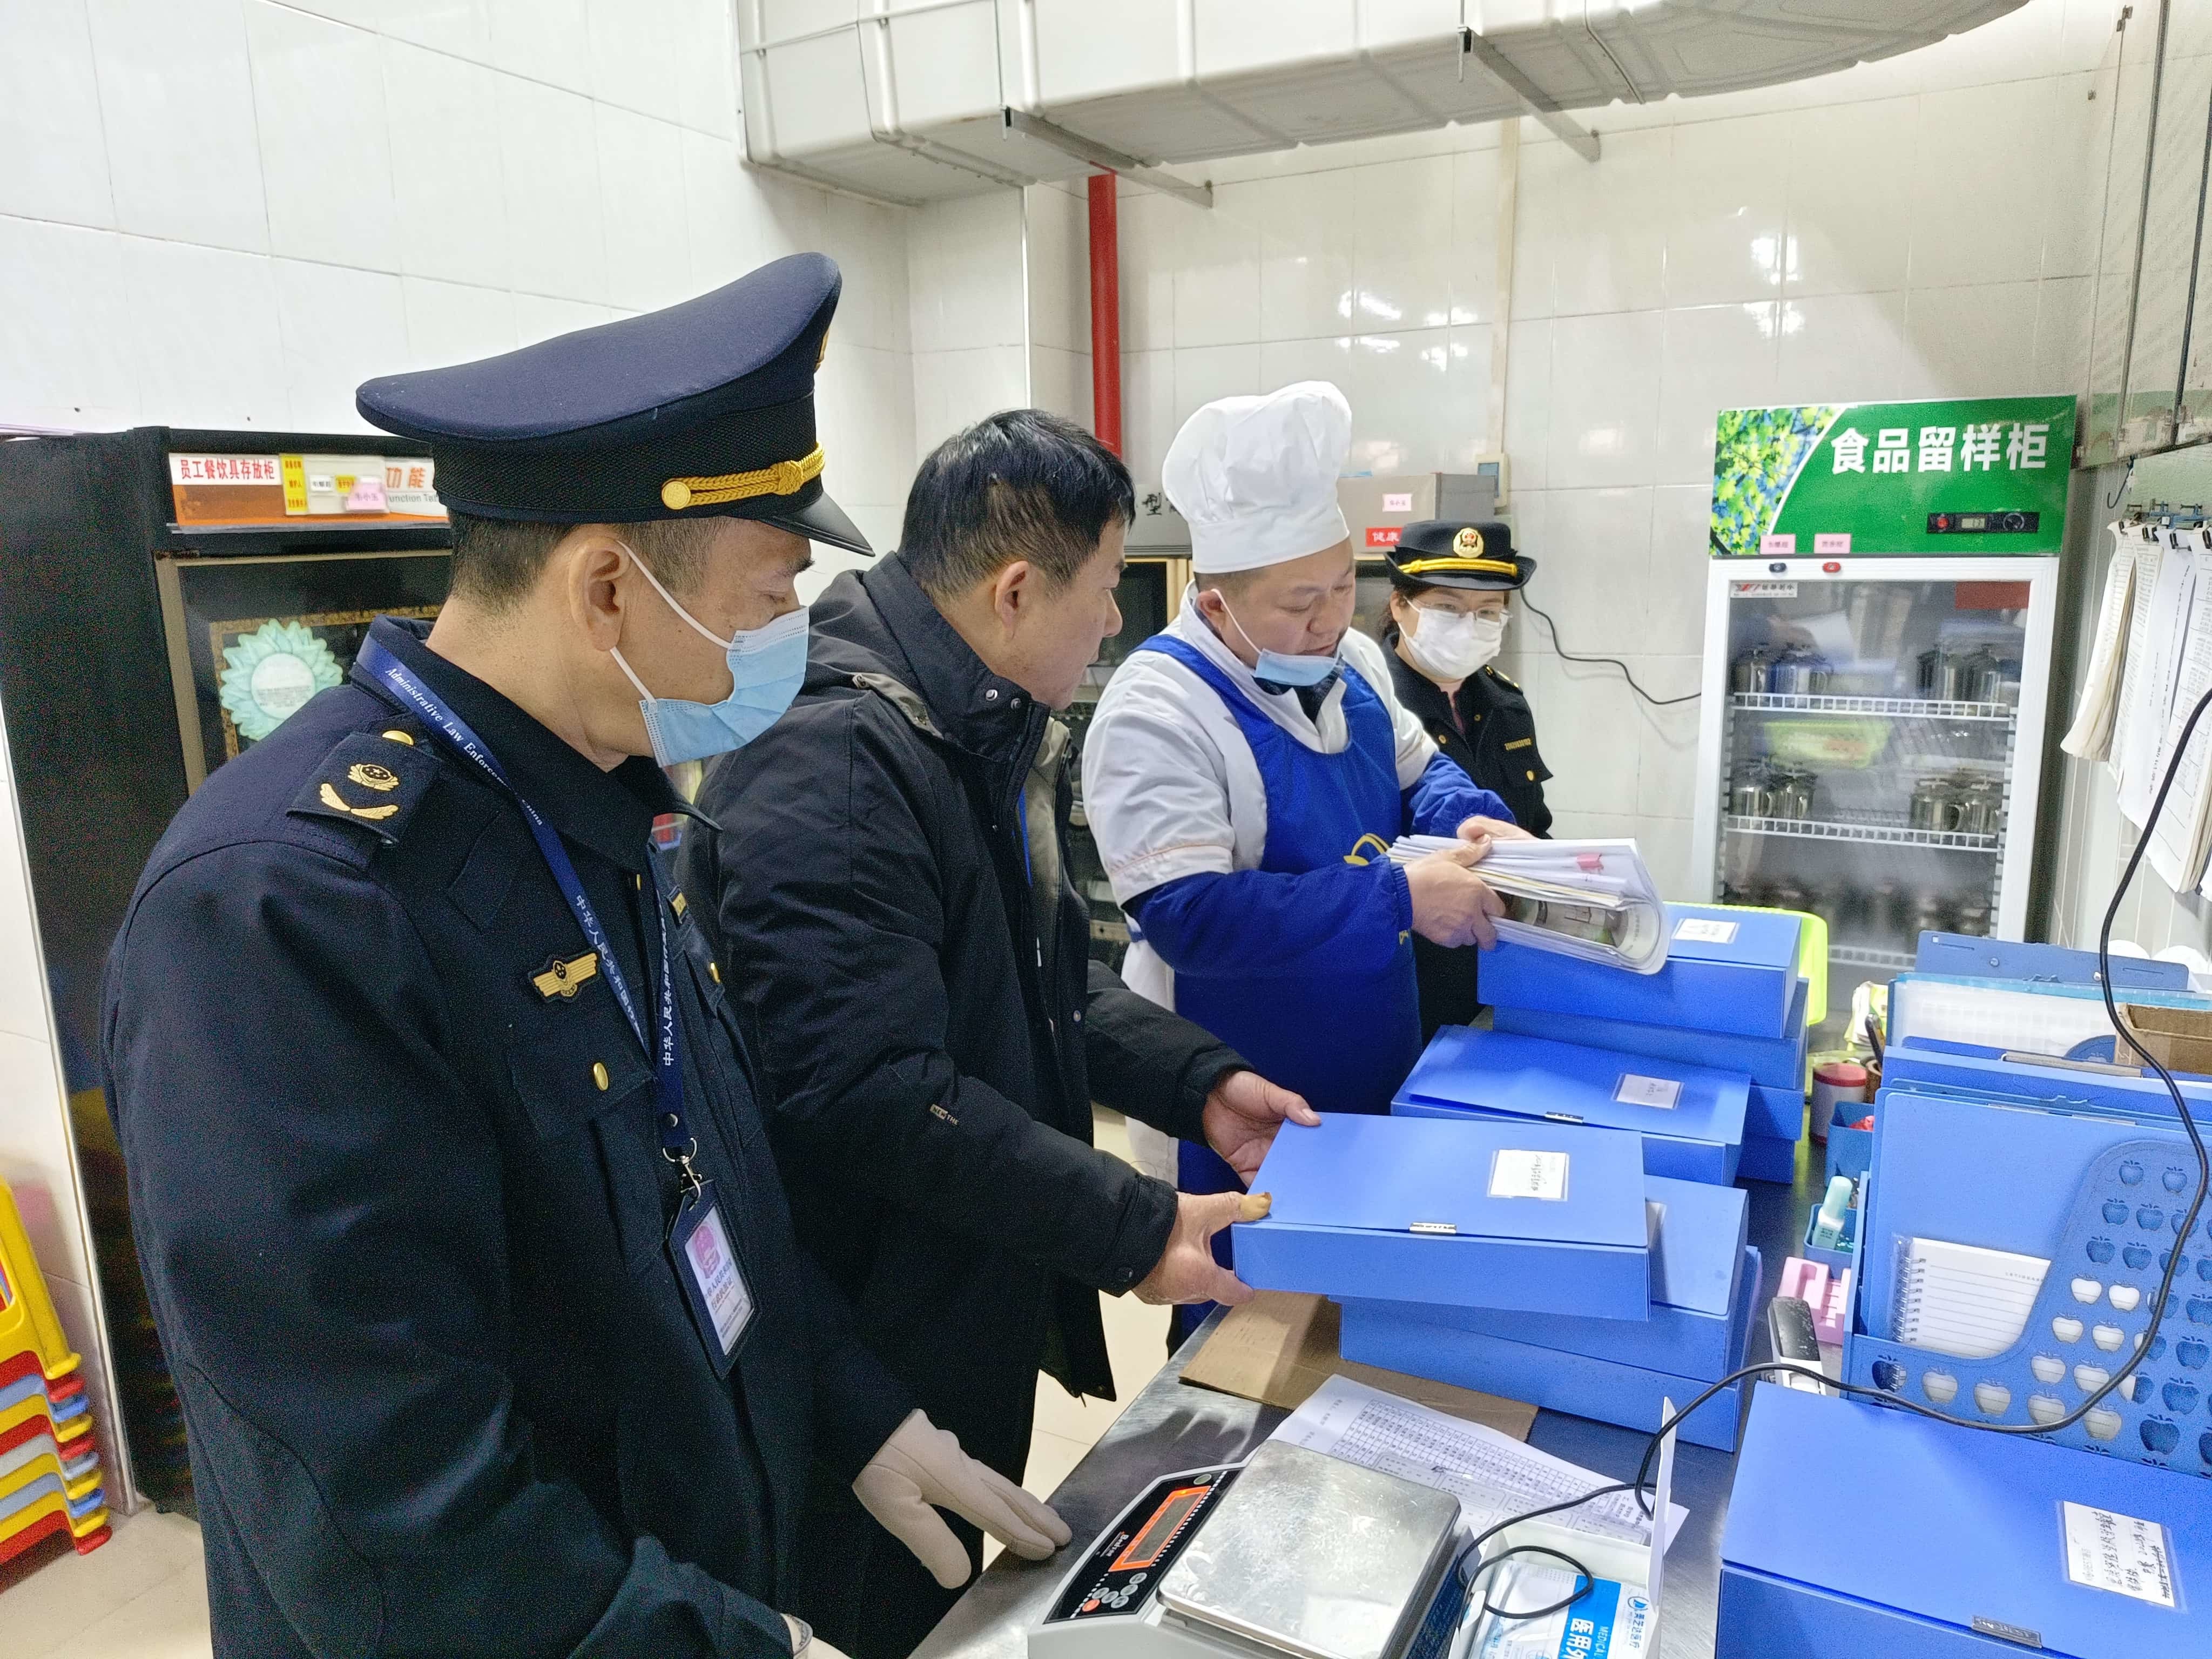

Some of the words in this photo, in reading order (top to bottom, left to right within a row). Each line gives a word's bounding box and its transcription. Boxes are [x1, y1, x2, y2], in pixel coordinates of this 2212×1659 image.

[1831, 423, 2050, 475] 食品留样柜
[181, 459, 274, 480] 员工餐饮具存放柜
[389, 494, 421, 503] unction
[385, 668, 443, 721] Administrative
[442, 721, 464, 741] Law
[947, 1114, 959, 1125] THE
[1594, 1625, 1609, 1656] MEDICAL
